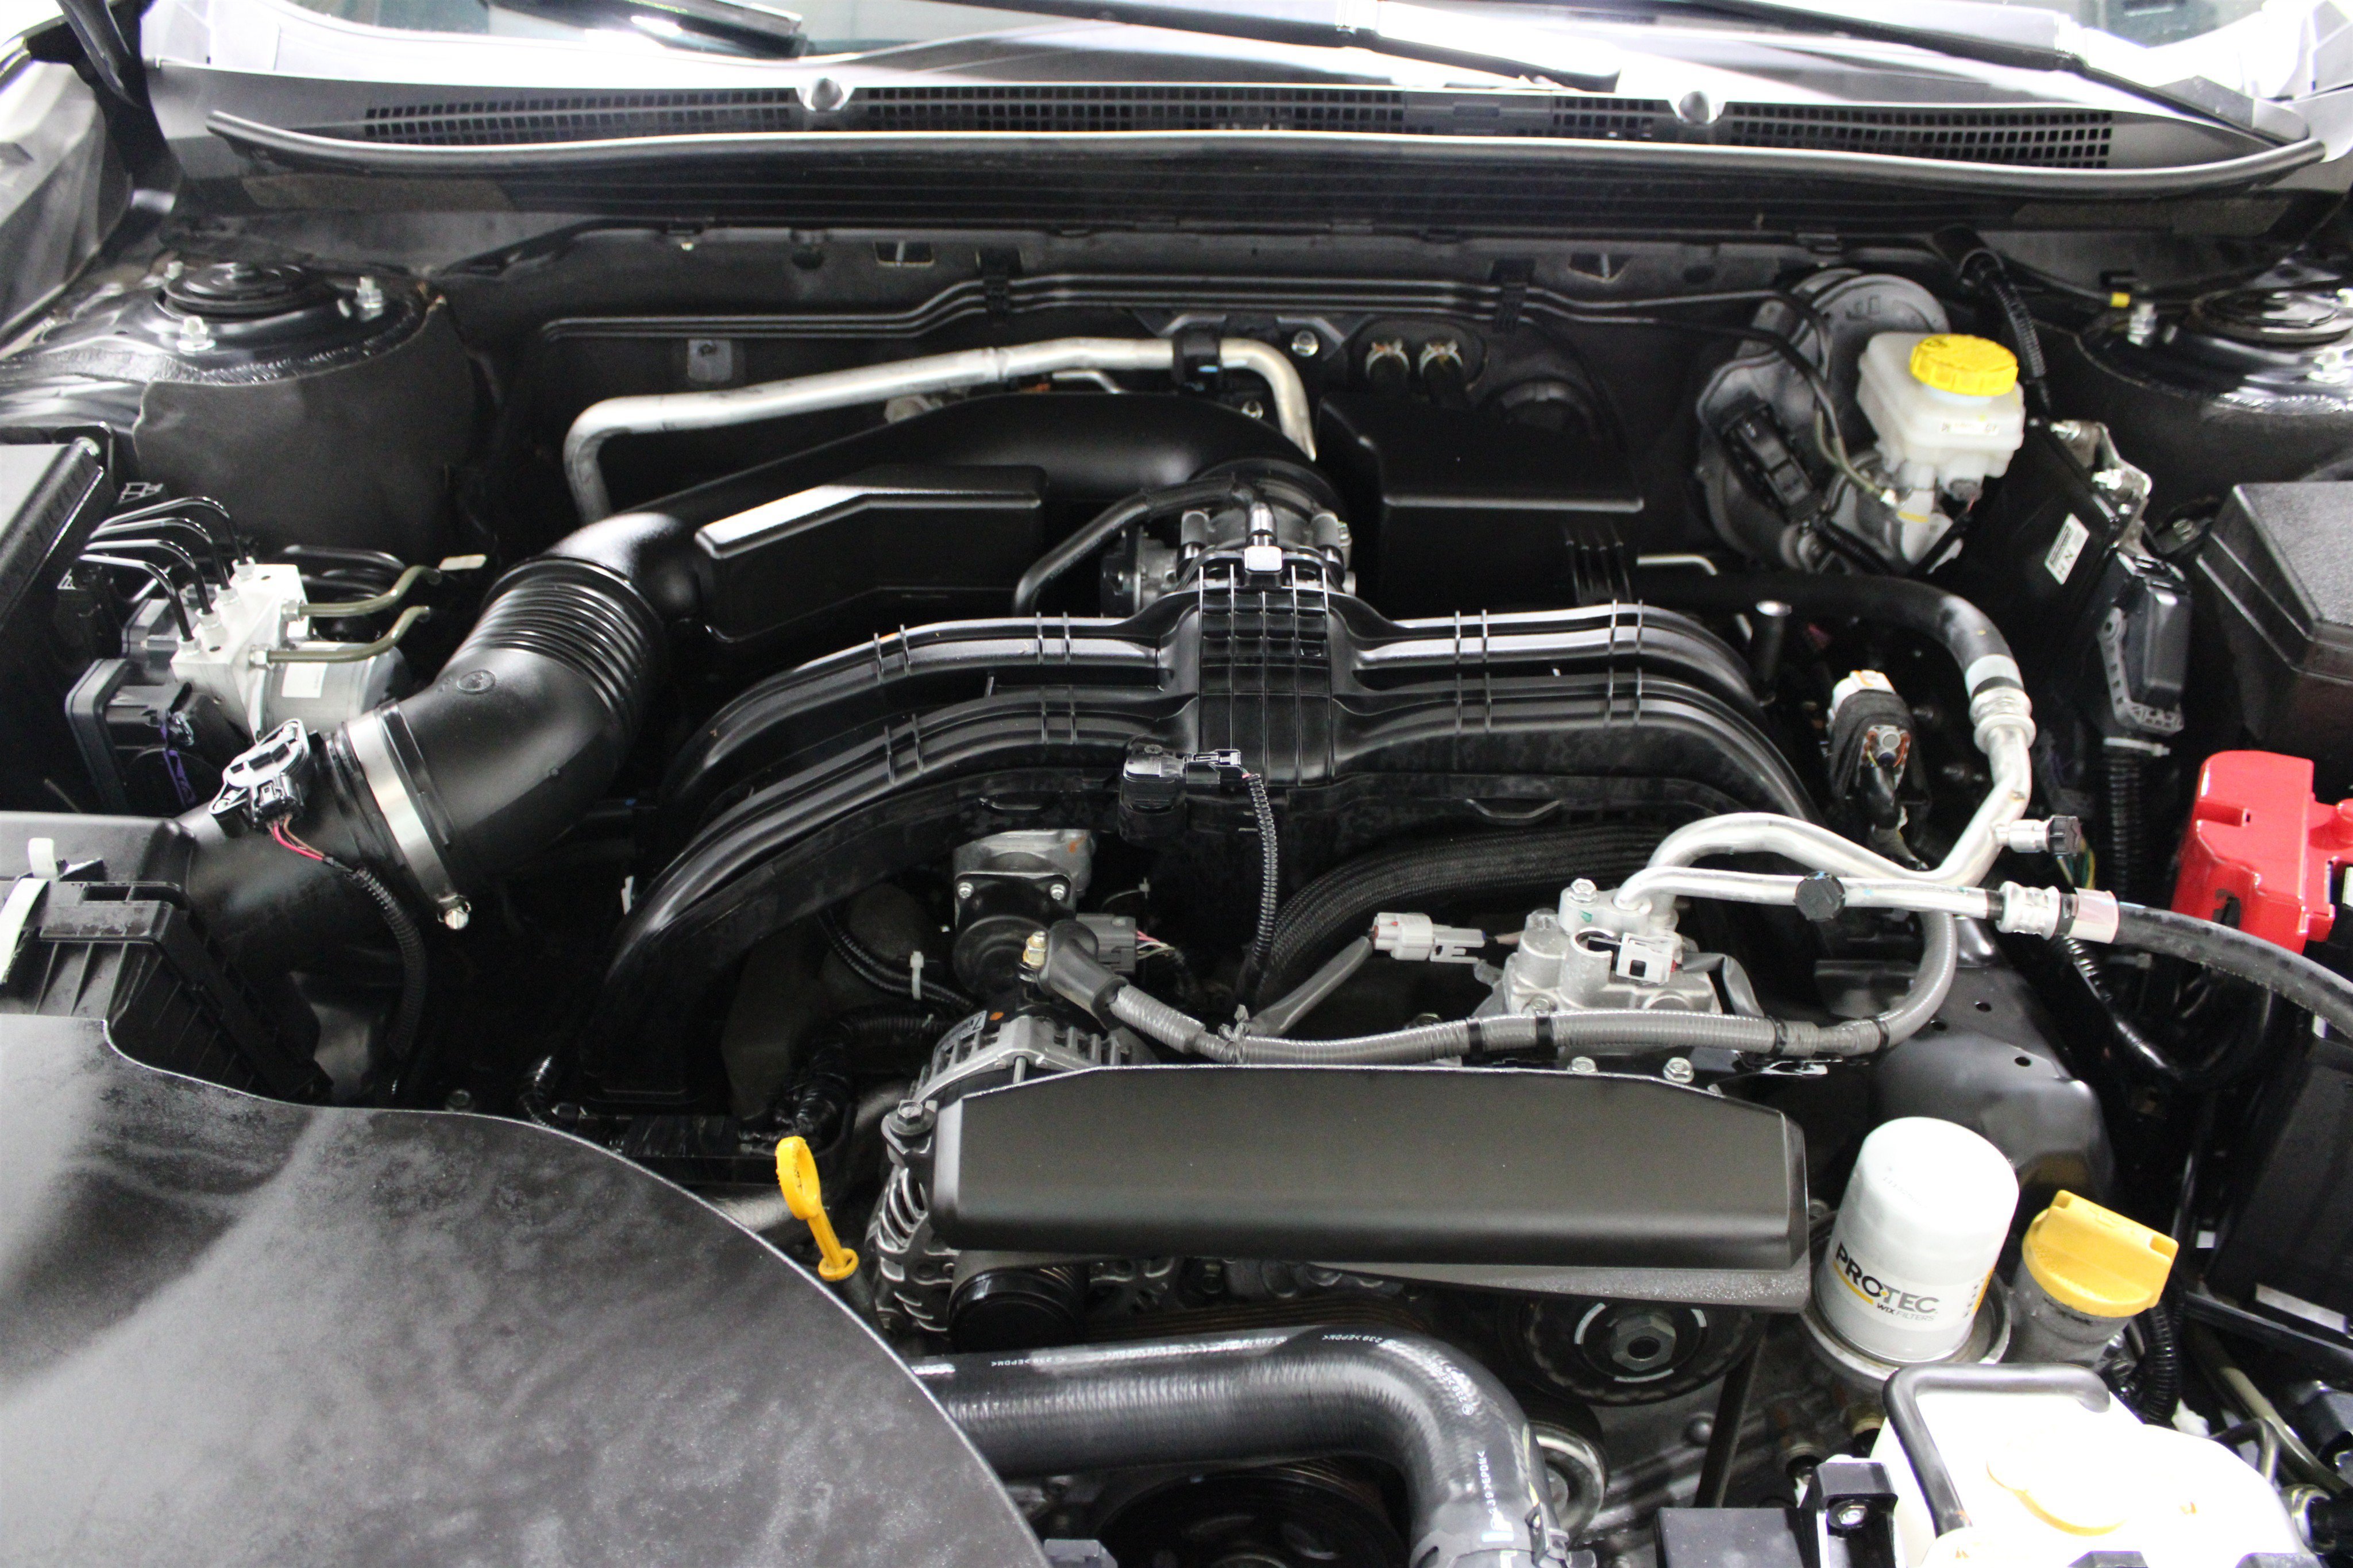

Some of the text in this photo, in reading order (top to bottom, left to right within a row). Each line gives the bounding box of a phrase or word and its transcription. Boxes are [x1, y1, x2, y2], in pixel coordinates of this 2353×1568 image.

[1835, 1241, 1939, 1314] PROTEC
[1877, 1303, 1935, 1322] WIX FILTERS
